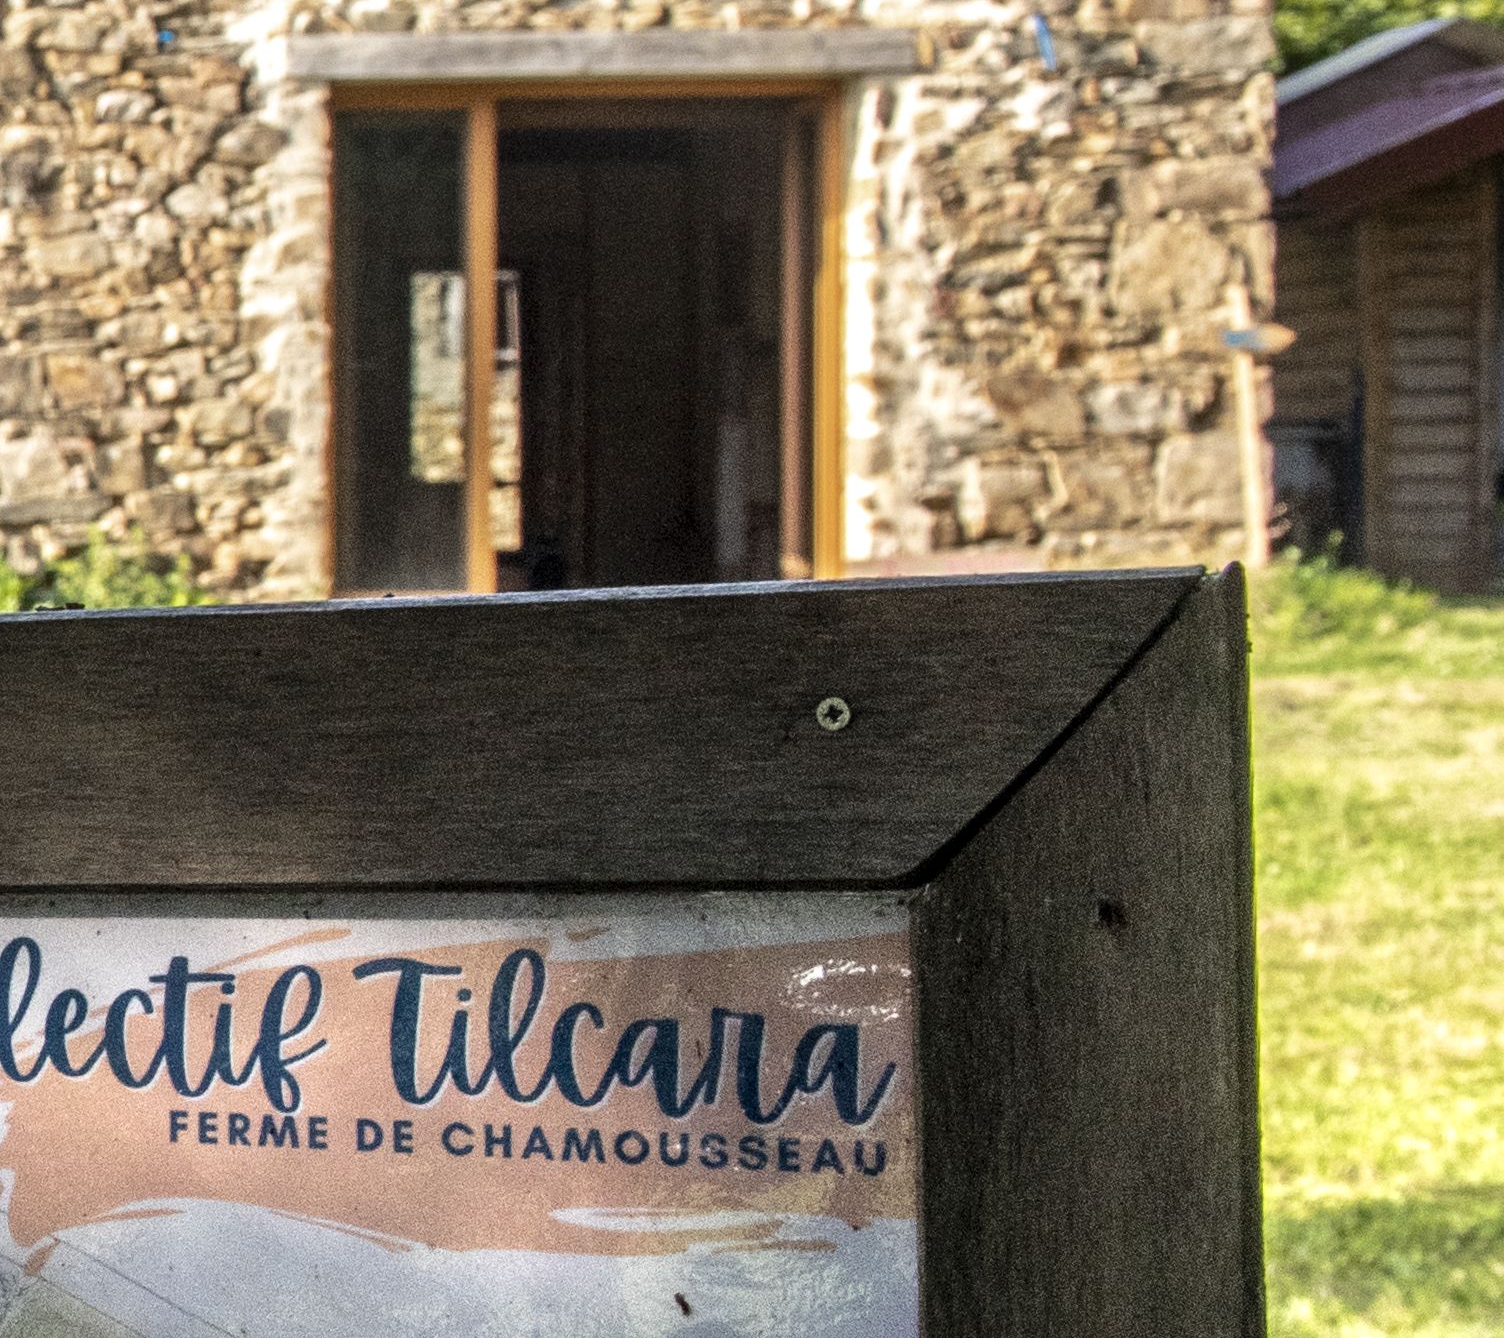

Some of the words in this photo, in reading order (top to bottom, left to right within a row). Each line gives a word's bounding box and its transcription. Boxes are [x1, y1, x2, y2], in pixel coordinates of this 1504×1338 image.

[352, 947, 896, 1126] Tilcara
[169, 1110, 329, 1150] FERME
[356, 1118, 414, 1157] DE
[441, 1121, 888, 1176] CHAMOUSSEAU
